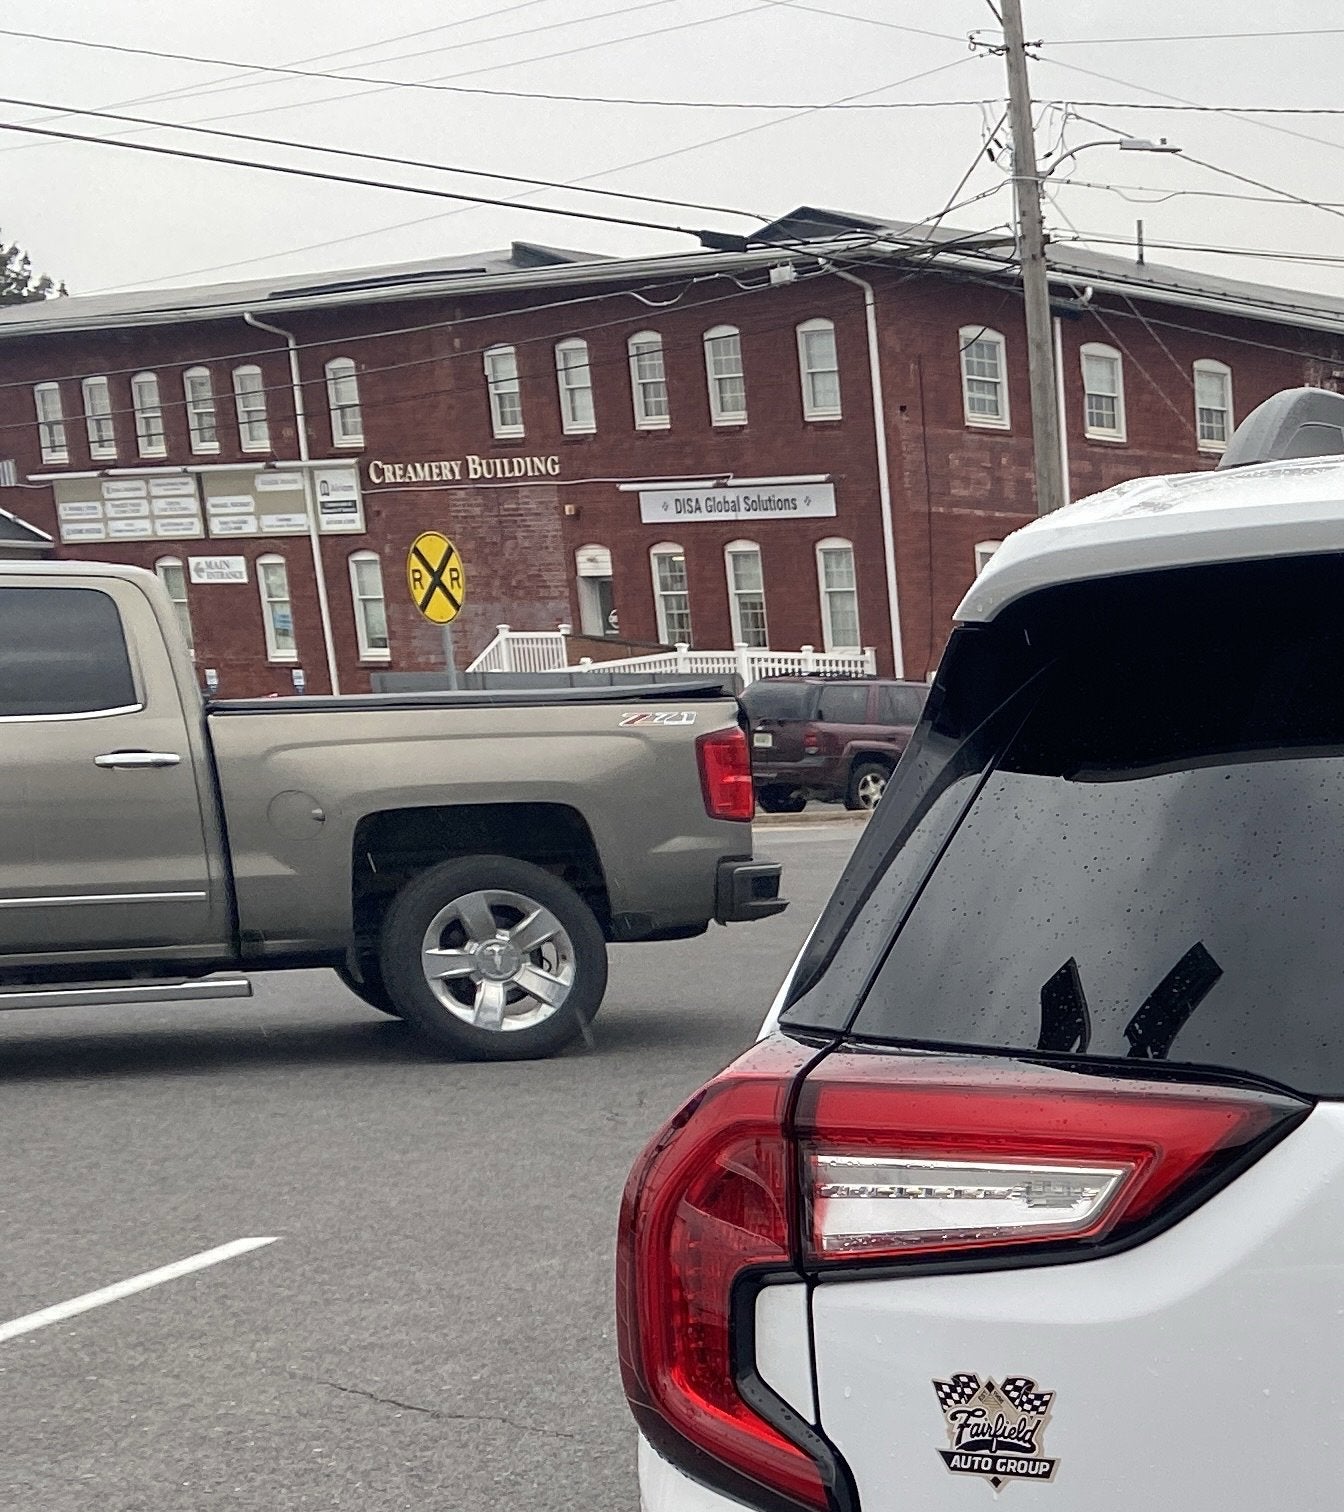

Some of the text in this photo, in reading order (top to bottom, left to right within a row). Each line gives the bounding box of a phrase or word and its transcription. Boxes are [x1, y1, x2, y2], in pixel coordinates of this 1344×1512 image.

[674, 495, 798, 514] DISA Global Solutions
[618, 711, 697, 726] Z71
[950, 1408, 1041, 1450] Fairfield
[950, 1455, 1050, 1475] AUTO GROUP
